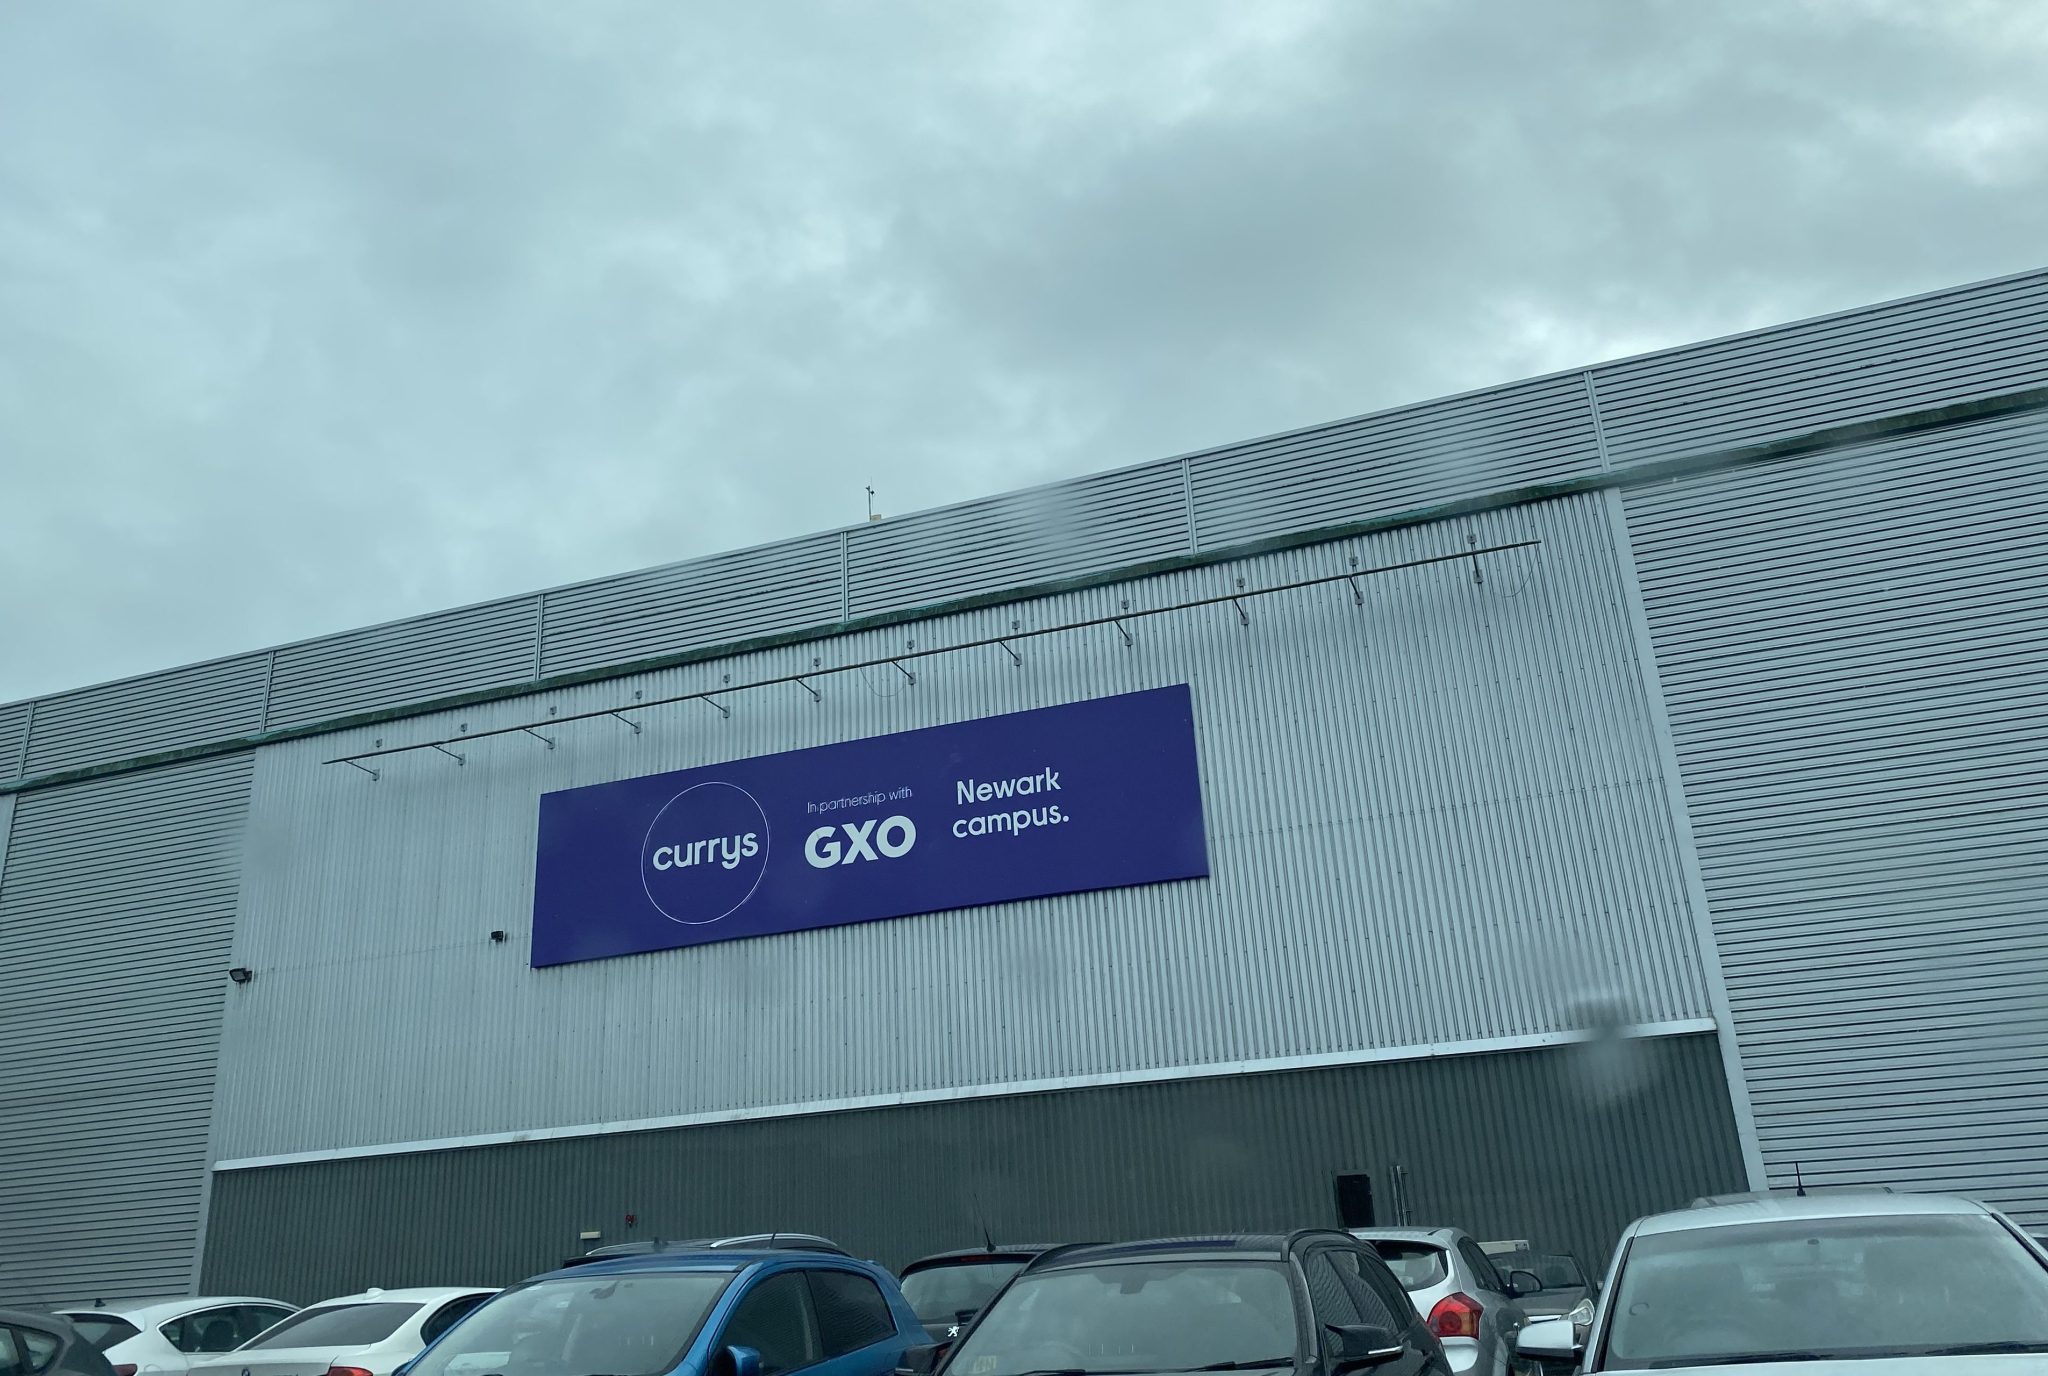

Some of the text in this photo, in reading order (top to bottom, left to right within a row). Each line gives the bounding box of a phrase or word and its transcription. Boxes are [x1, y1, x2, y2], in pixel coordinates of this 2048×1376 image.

[806, 786, 913, 815] In partnership with
[957, 767, 1061, 805] Newark
[953, 806, 1069, 838] campus.
[653, 833, 758, 870] currys
[804, 816, 916, 868] GXO
